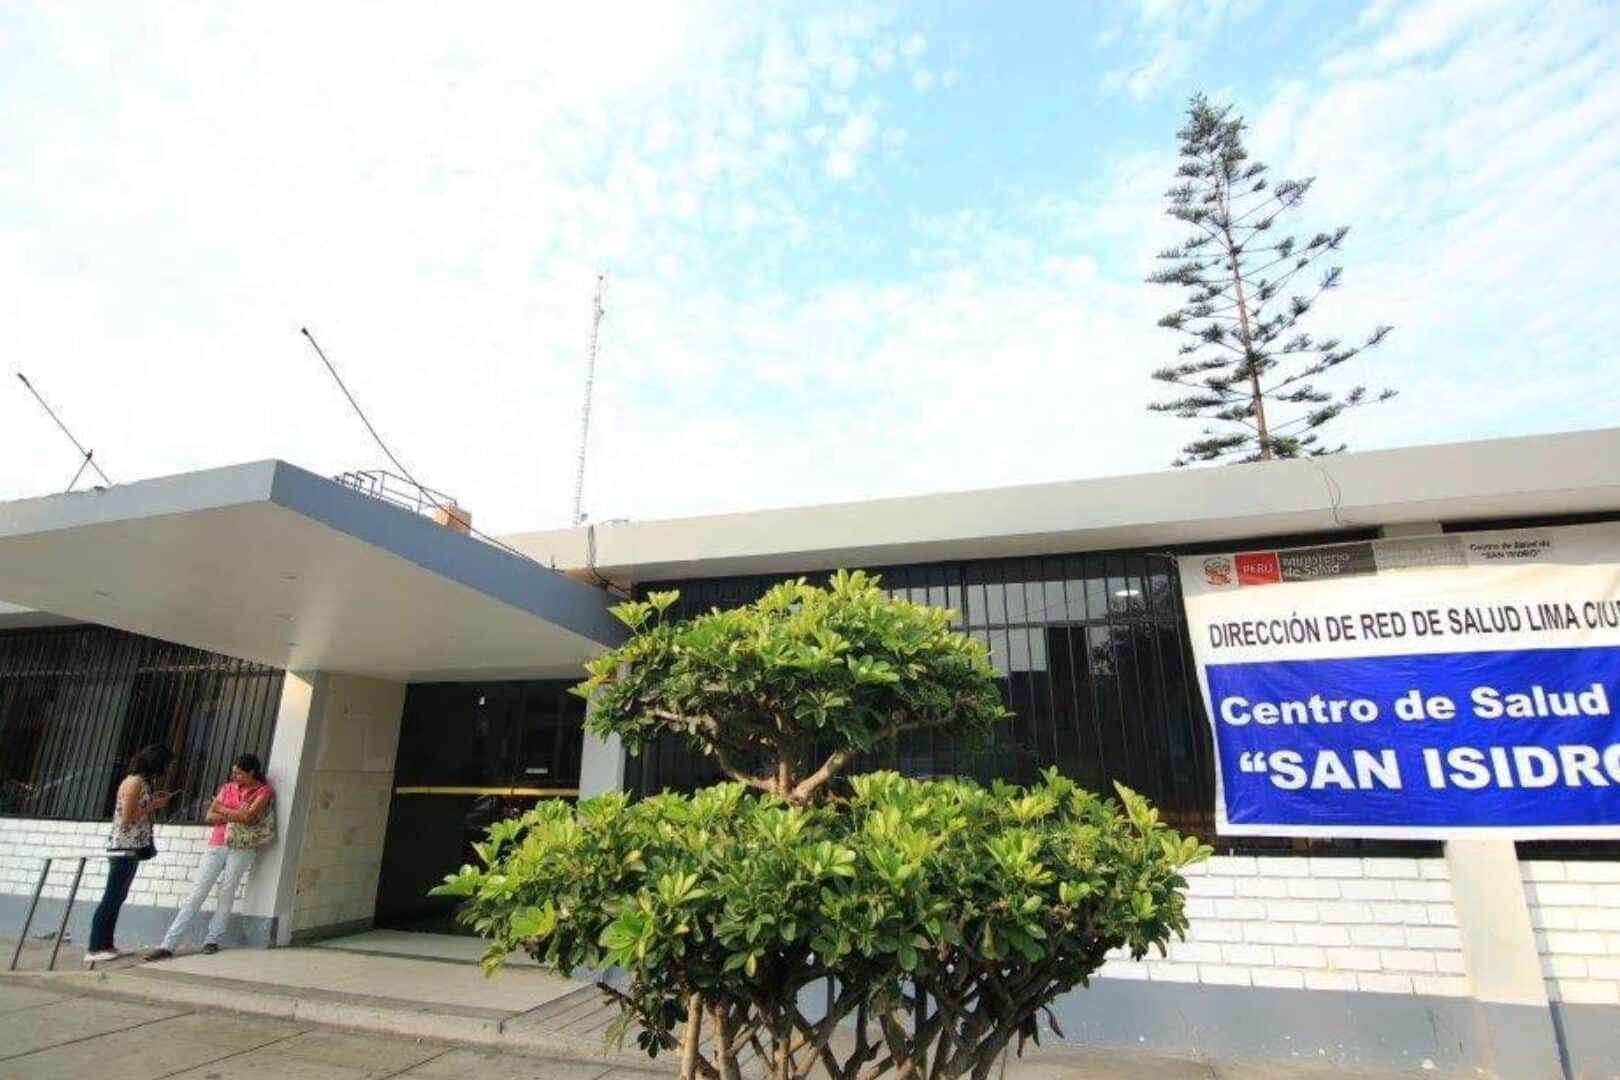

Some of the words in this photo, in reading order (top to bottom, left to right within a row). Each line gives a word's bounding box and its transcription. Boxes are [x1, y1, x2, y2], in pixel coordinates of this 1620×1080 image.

[1283, 553, 1350, 567] Ministerio
[1283, 566, 1299, 577] de
[1303, 563, 1341, 577] Salud
[1209, 612, 1321, 648] DIRECCIÓN
[1325, 615, 1356, 642] DE
[1360, 612, 1406, 640] RED
[1412, 610, 1444, 637] DE
[1450, 605, 1521, 634] SALUD
[1525, 602, 1581, 631] LIMA
[1584, 600, 1620, 629] CIU
[1220, 694, 1379, 726] Centro
[1394, 689, 1456, 721] de
[1470, 683, 1610, 719] Salud
